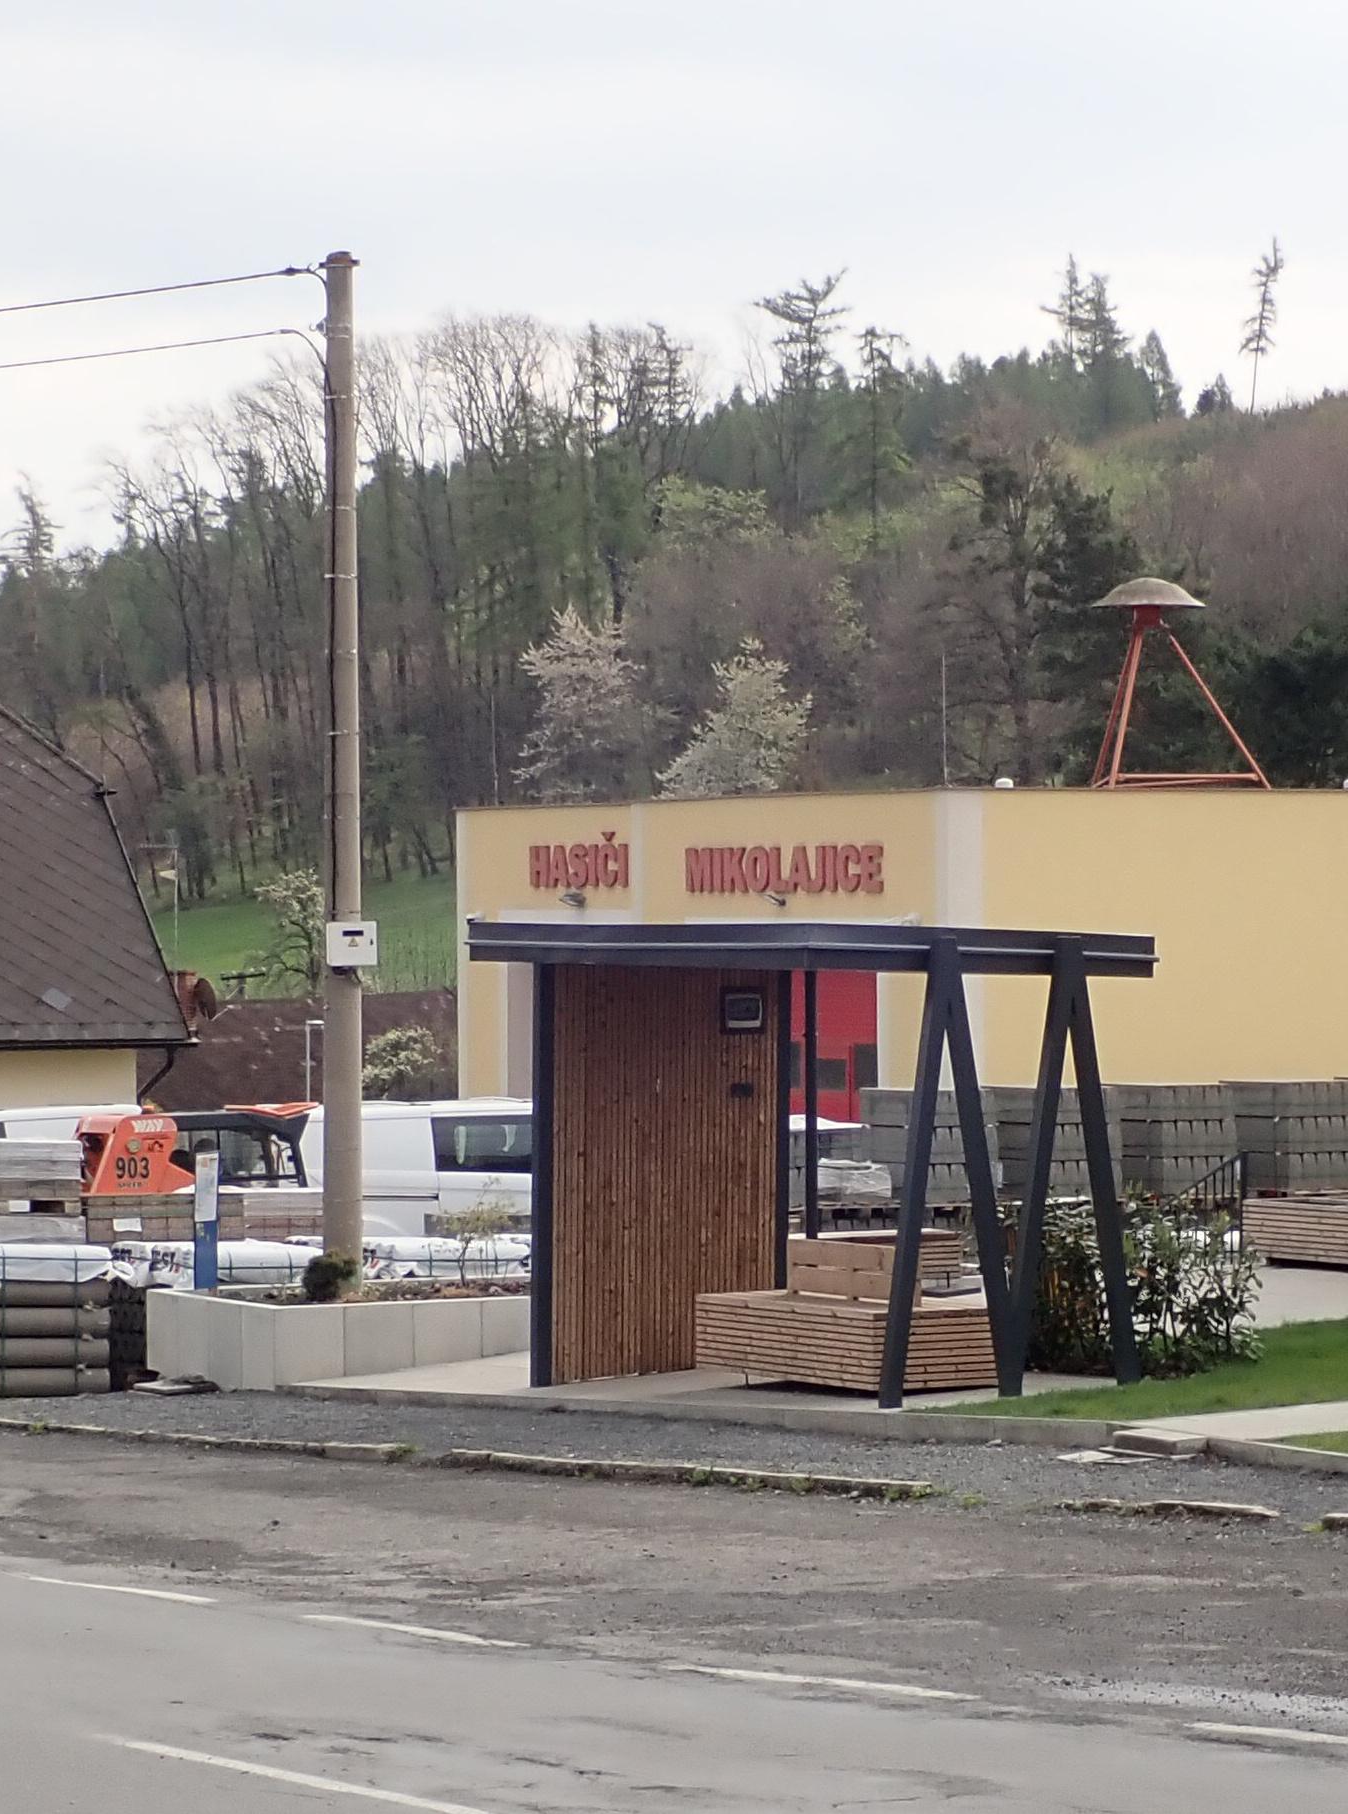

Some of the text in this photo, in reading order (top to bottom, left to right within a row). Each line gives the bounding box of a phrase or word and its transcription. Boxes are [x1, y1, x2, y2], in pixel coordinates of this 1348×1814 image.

[529, 831, 884, 894] HASIČI MIKOLAJICE
[116, 1157, 150, 1179] 903
